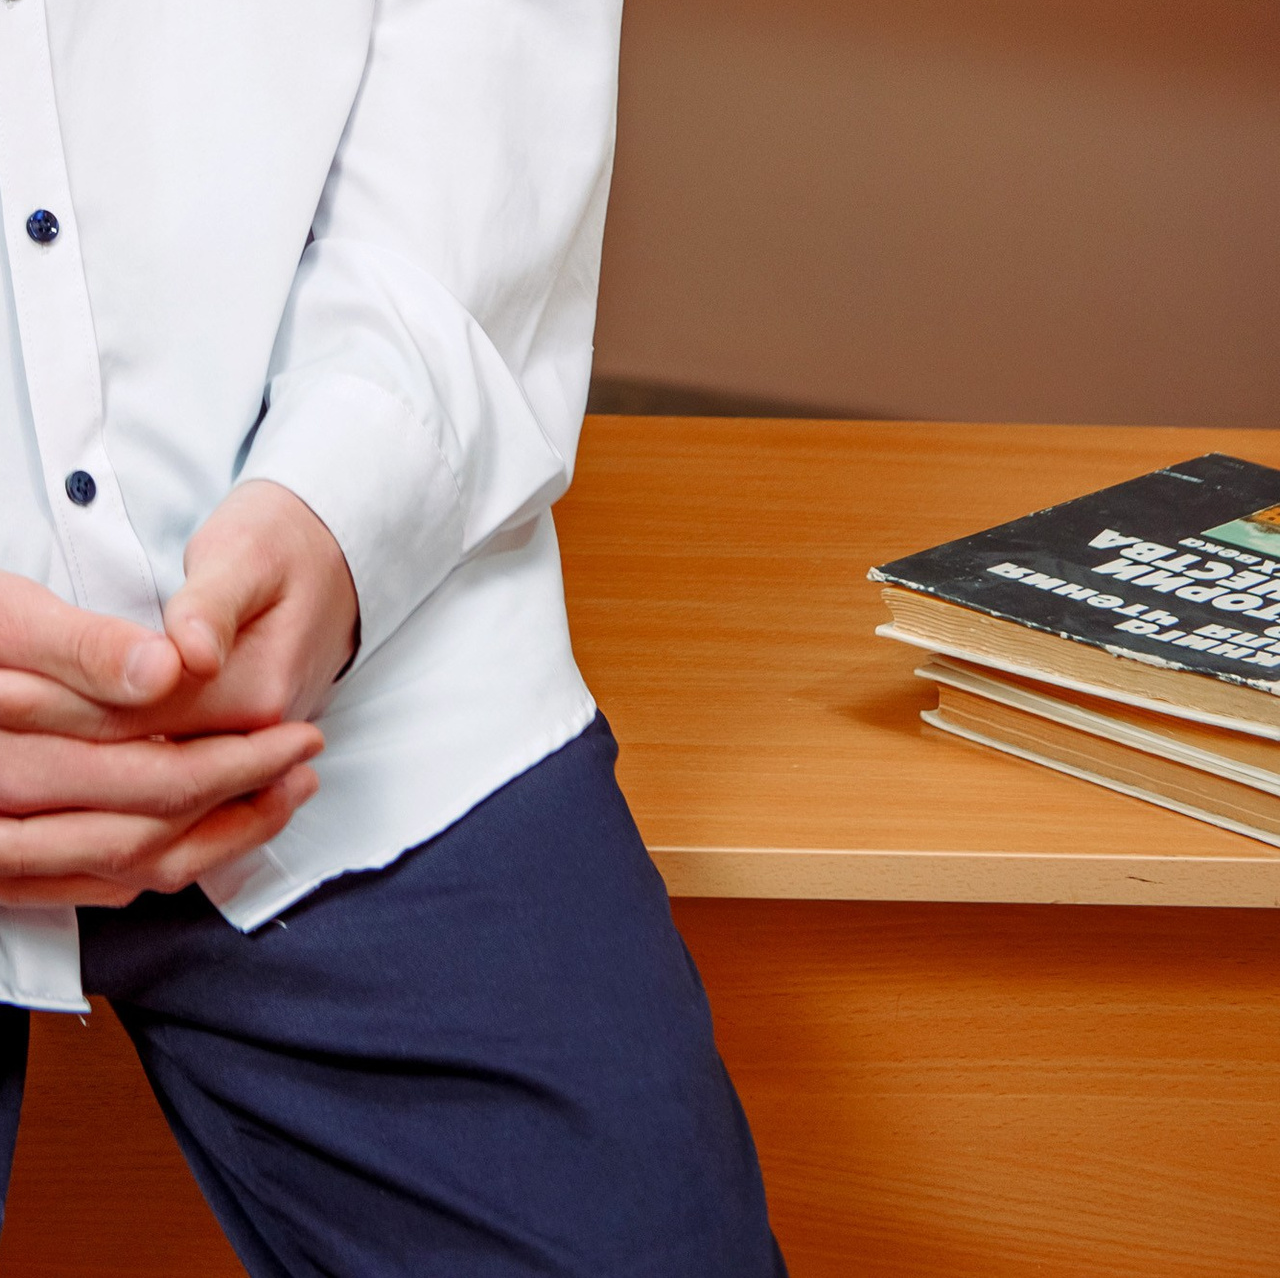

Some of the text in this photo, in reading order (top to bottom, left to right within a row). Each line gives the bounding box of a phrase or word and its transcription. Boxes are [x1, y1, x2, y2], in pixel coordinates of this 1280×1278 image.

[986, 562, 1180, 627] чтения
[1087, 528, 1280, 602] ЧЕСТВА
[1090, 558, 1280, 623] ТОРИИ
